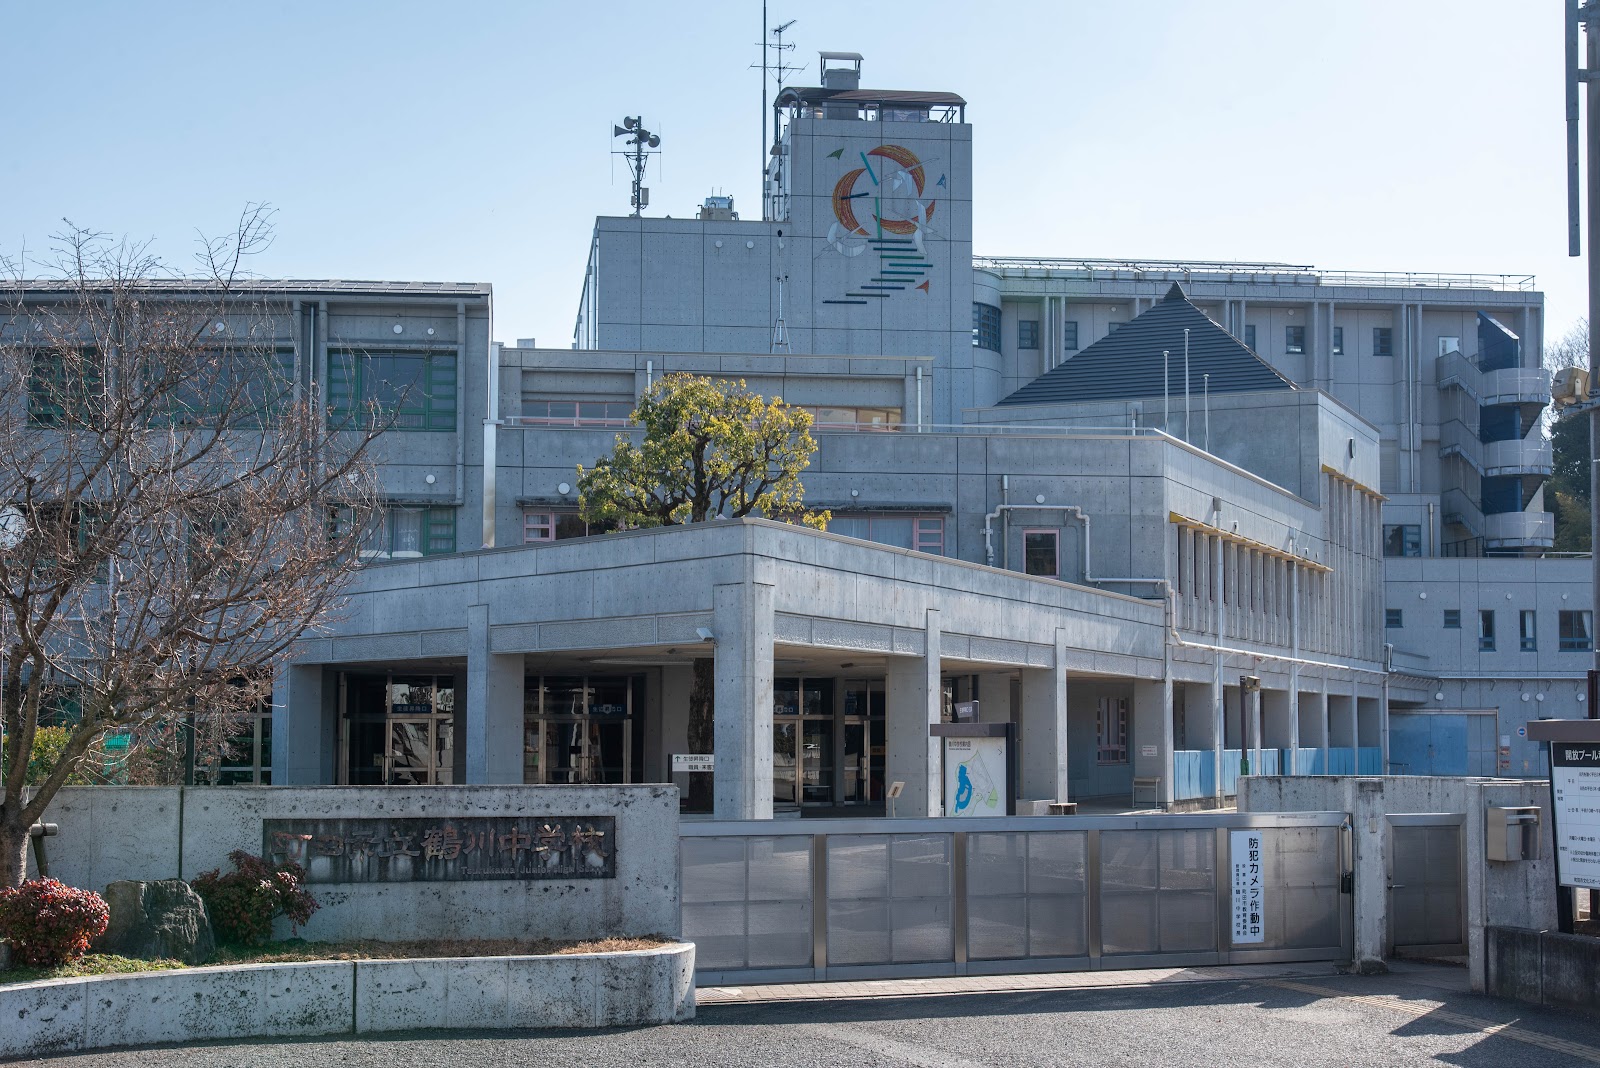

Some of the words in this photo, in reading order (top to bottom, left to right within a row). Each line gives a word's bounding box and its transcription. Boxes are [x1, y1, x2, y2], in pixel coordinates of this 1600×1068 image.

[1248, 837, 1260, 936] 防犯カメラ作動中
